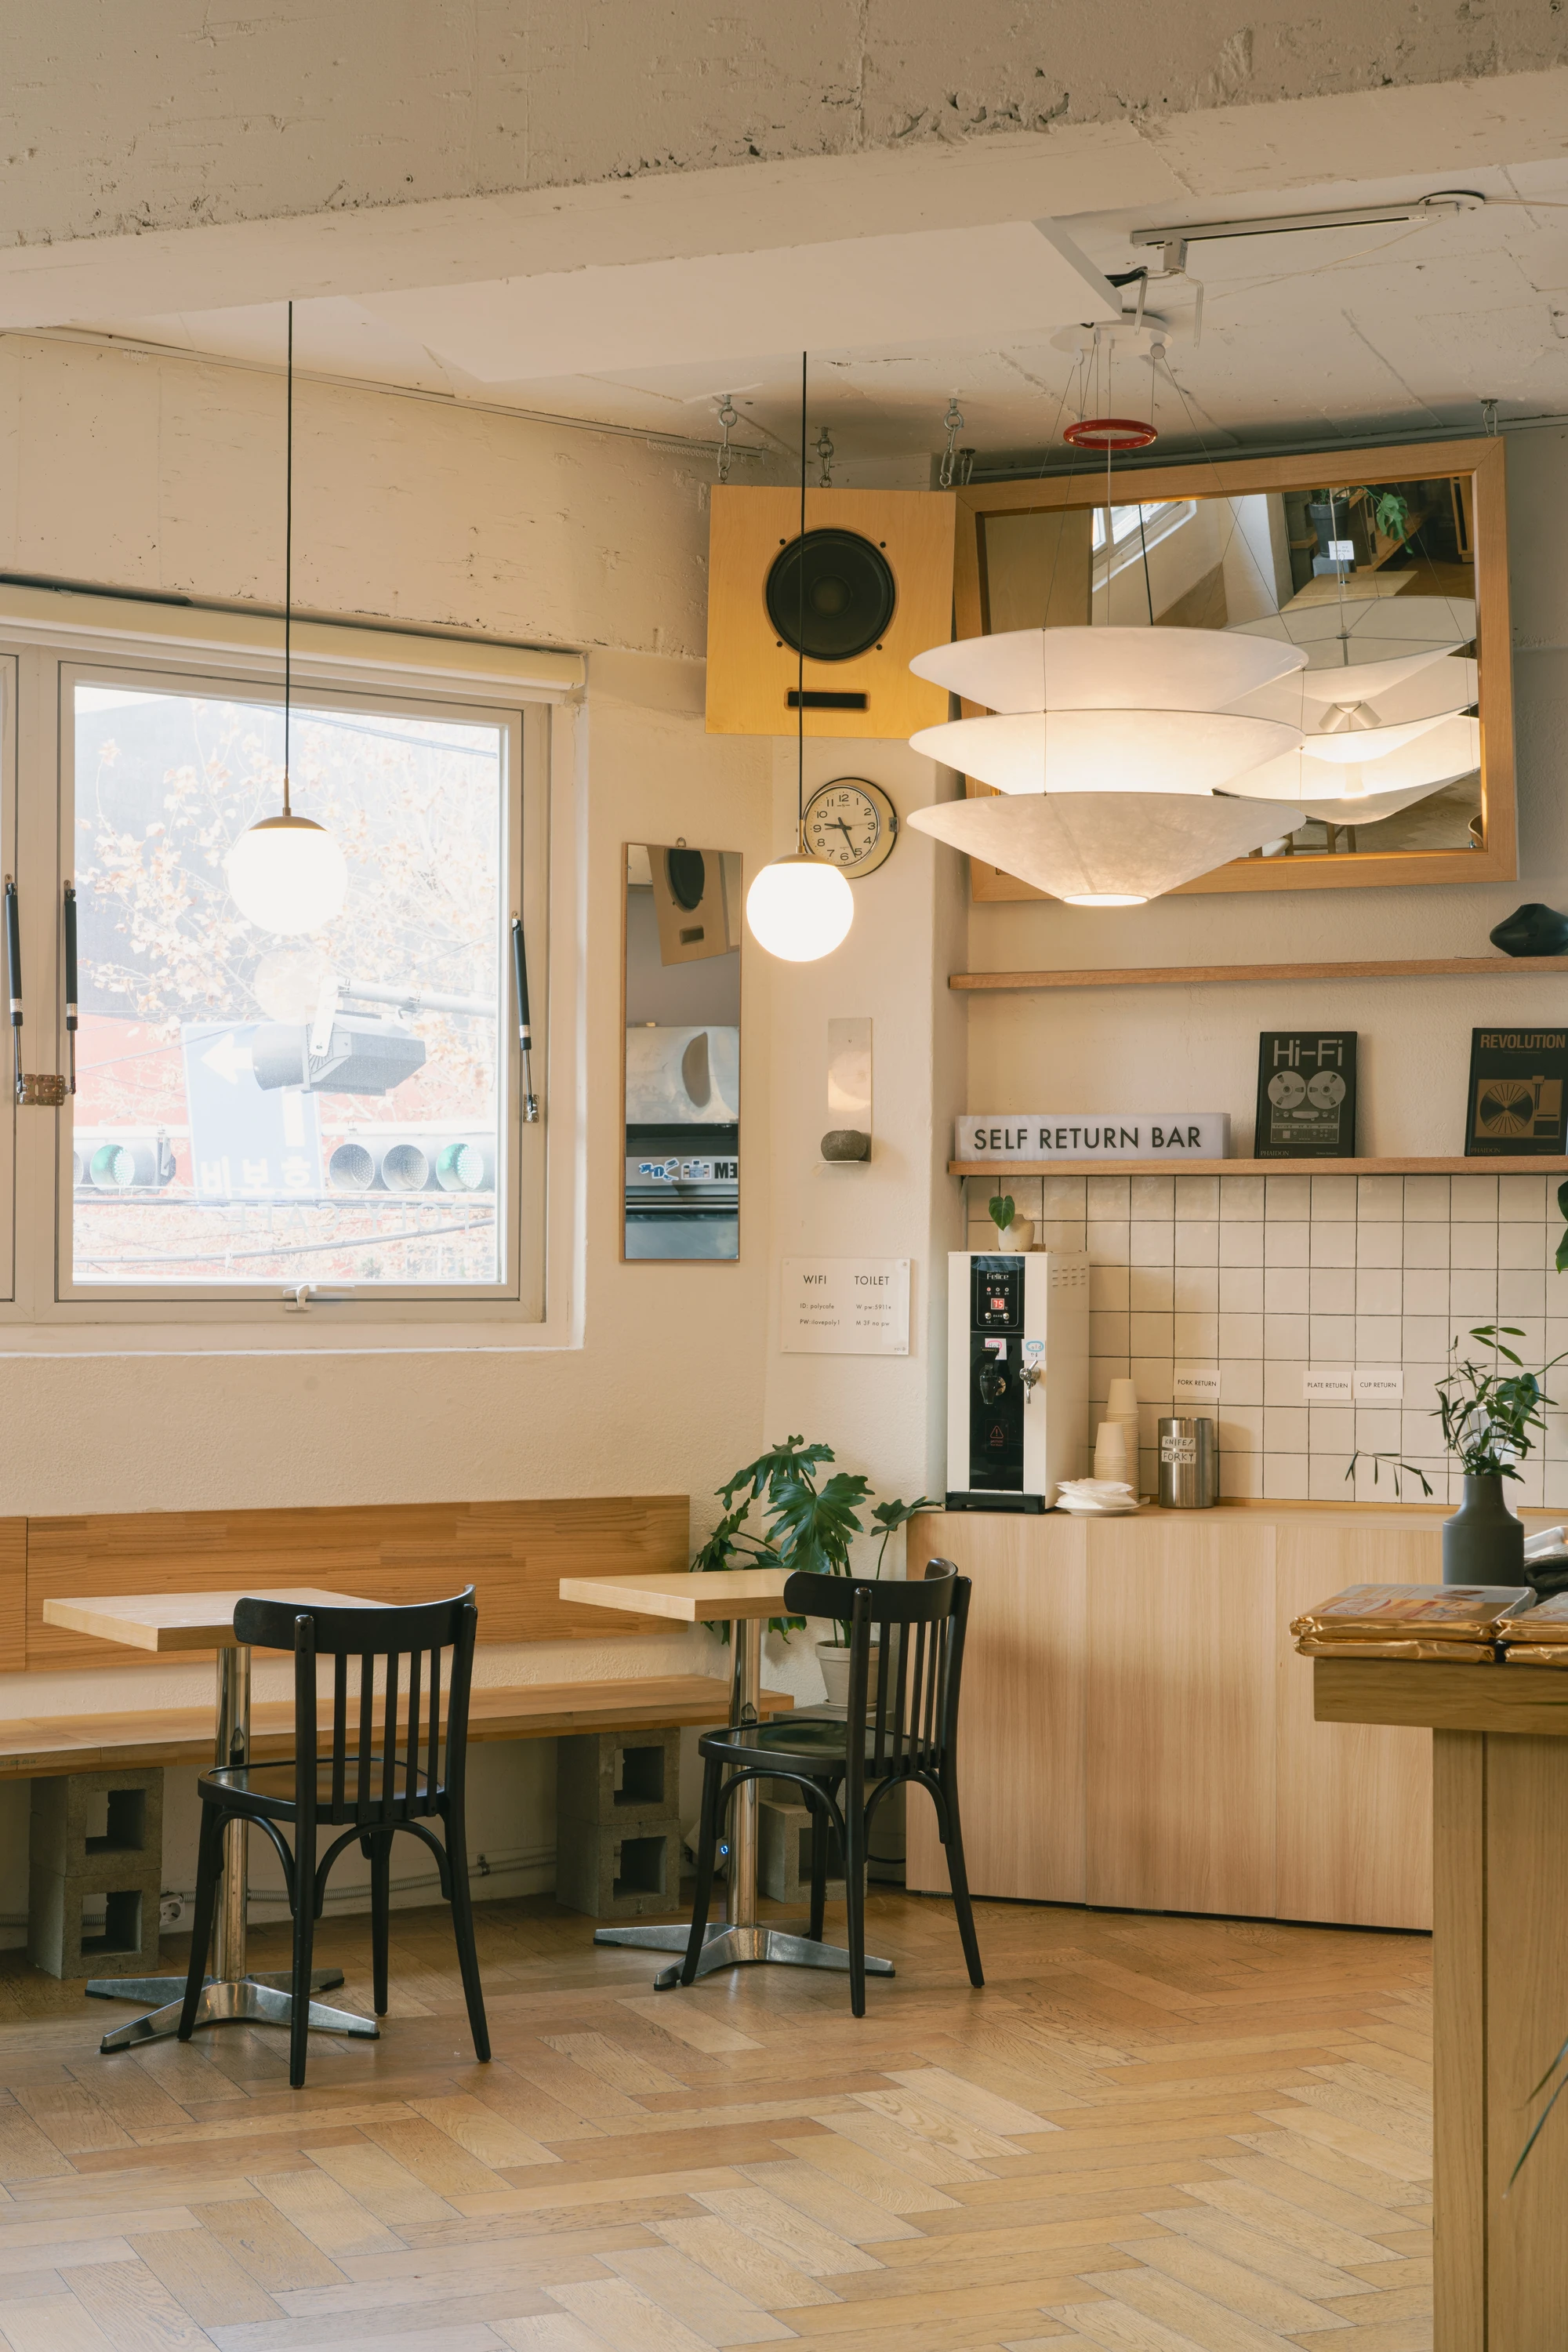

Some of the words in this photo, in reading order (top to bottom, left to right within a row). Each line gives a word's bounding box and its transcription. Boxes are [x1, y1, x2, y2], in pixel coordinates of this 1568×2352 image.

[839, 793, 848, 802] 12
[1480, 1034, 1566, 1048] REVOLUTION
[1273, 1040, 1343, 1066] Hi-Fi
[974, 1128, 1029, 1151] SELF
[1040, 1127, 1139, 1150] RETURN
[1151, 1126, 1201, 1148] BAR
[200, 1155, 316, 1199] 비보호
[803, 1275, 826, 1284] WIFI
[855, 1276, 890, 1286] TOILET
[993, 1300, 1004, 1308] 75
[1163, 1452, 1187, 1461] FORK
